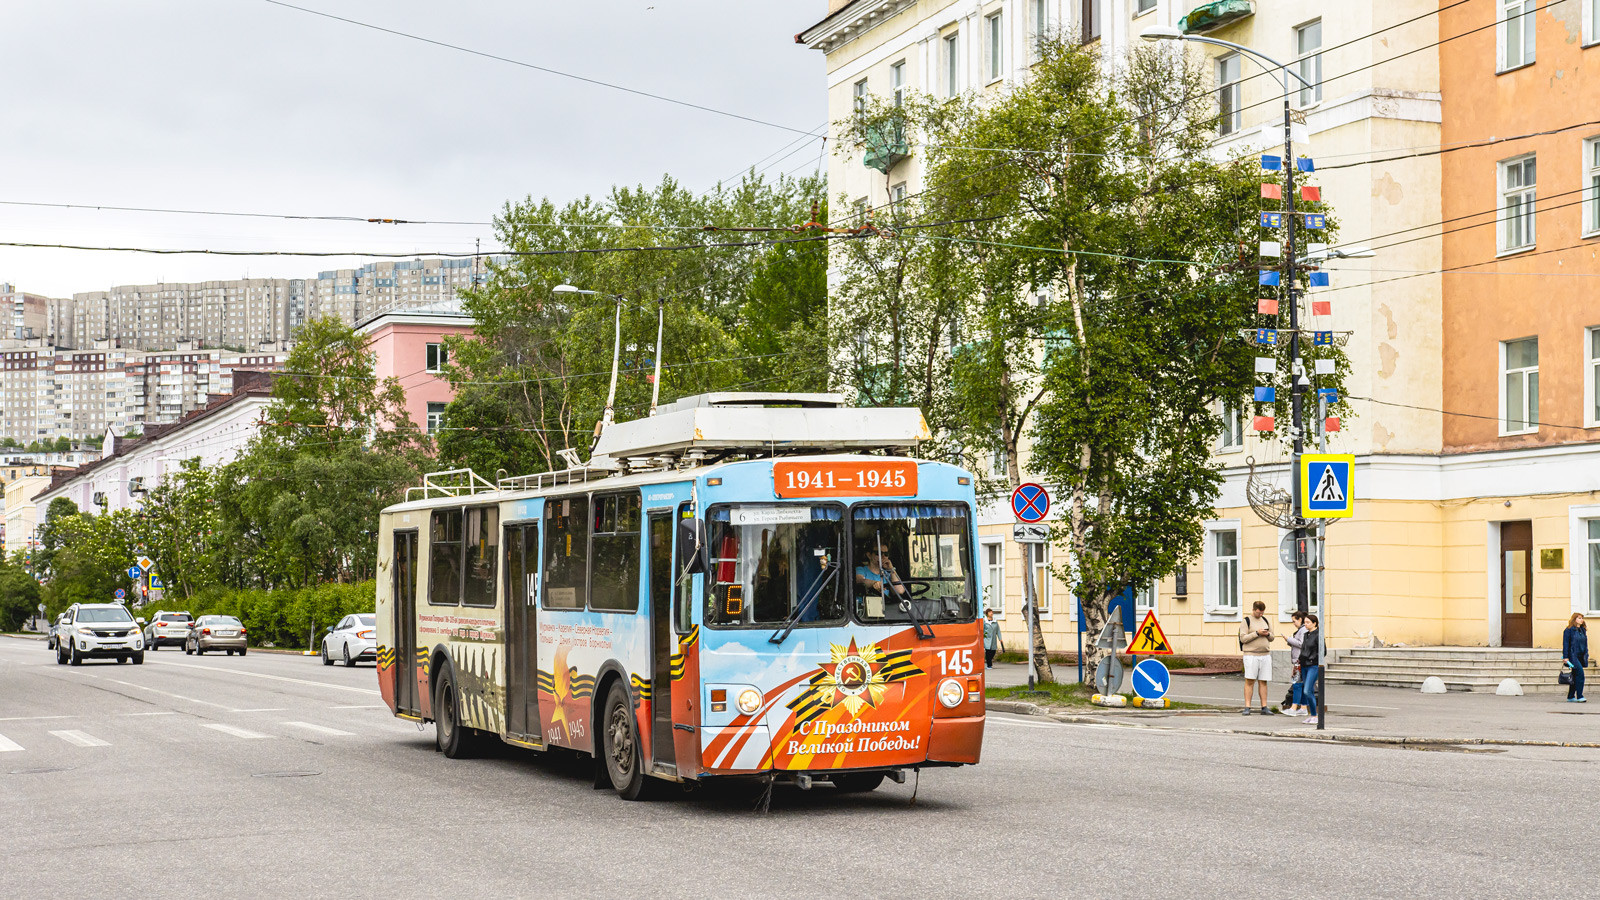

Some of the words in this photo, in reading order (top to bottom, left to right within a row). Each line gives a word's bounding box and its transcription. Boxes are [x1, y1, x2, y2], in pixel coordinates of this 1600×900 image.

[739, 511, 746, 522] 6
[726, 585, 742, 615] 6
[936, 649, 974, 675] 145
[548, 726, 561, 744] 1941
[569, 718, 585, 739] 1945
[799, 720, 812, 736] С
[813, 718, 910, 738] Праздником
[786, 738, 854, 755] Великой
[857, 735, 921, 752] Победы!
